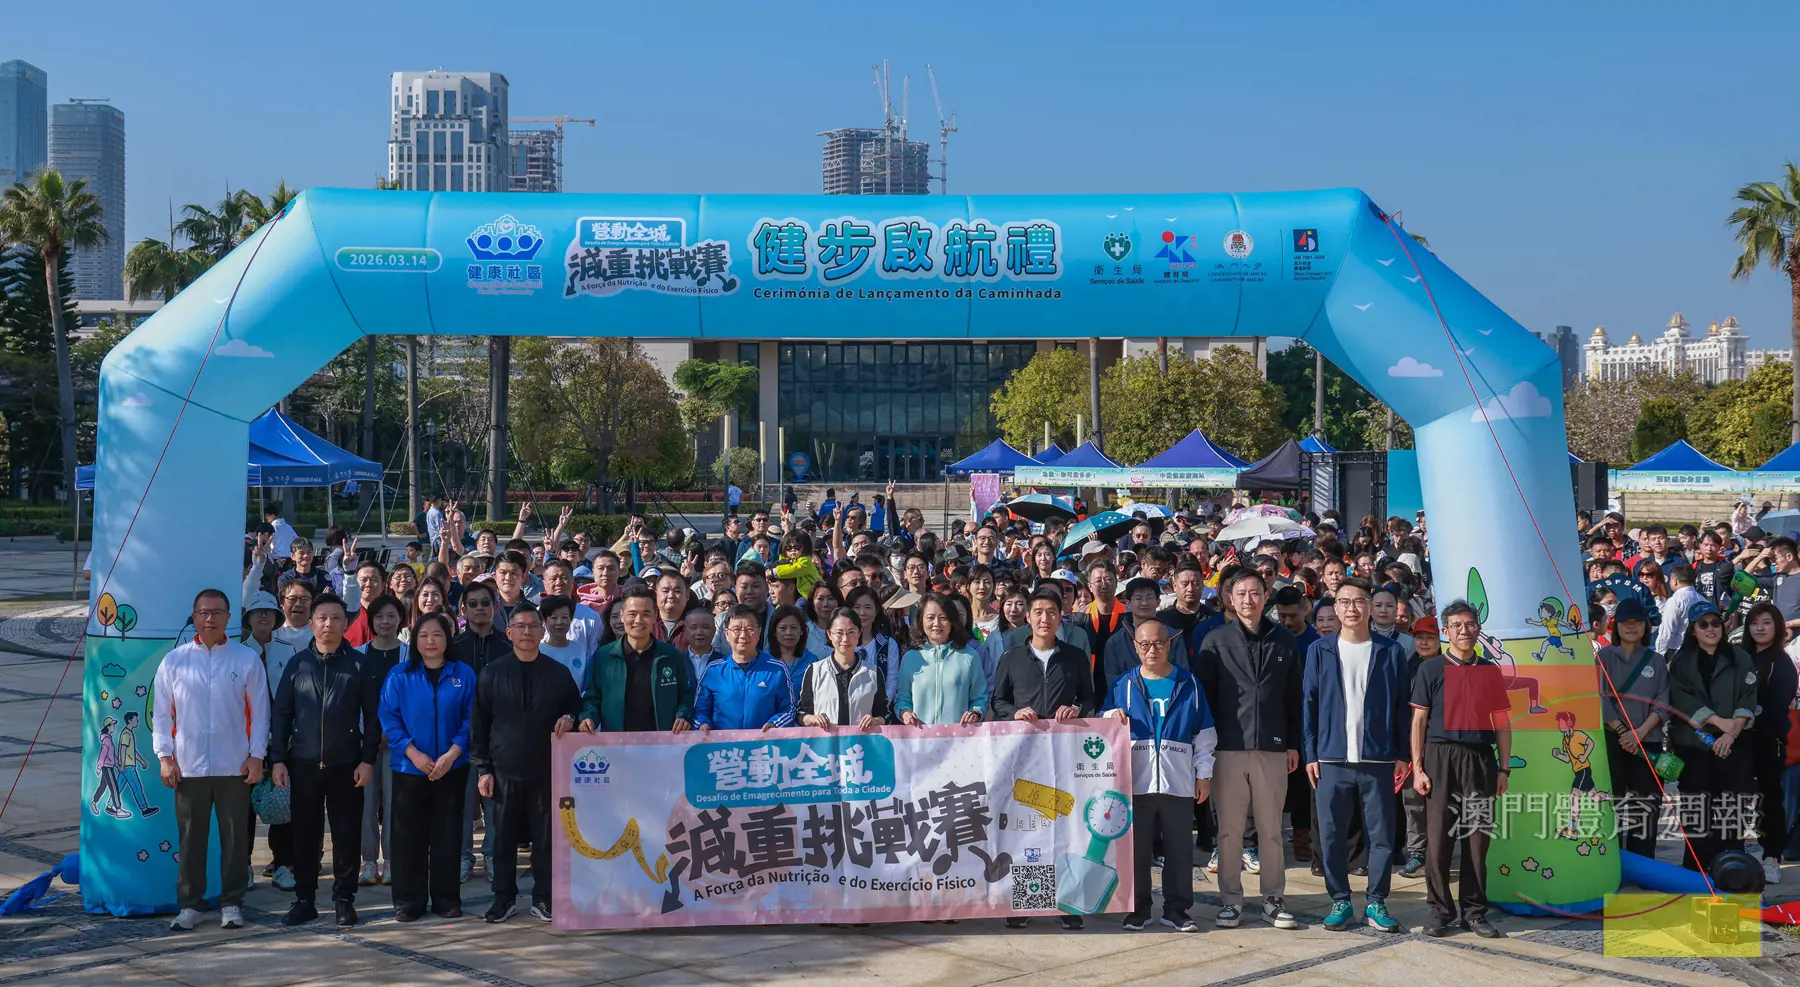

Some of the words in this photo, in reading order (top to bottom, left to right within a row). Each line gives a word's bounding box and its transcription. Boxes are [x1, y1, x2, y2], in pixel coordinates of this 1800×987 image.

[592, 222, 671, 242] 營動全城
[753, 220, 1058, 280] 健步啟航禮
[350, 254, 427, 266] 2026.03.14
[568, 243, 728, 282] 減重挑戰賽
[467, 264, 542, 280] 健康社區
[1094, 264, 1142, 276] 衛生局
[587, 282, 605, 290] Força
[617, 280, 647, 288] Nutrição
[667, 285, 697, 293] Exercício
[698, 286, 719, 294] Físico
[754, 286, 830, 299] Cerimónia
[836, 288, 853, 299] de
[859, 288, 950, 301] Lançamento
[955, 288, 972, 299] da
[978, 287, 1061, 299] Caminhada
[707, 743, 872, 790] 營動全城
[1076, 761, 1115, 771] 衛生局
[696, 792, 728, 802] Desafio
[730, 792, 741, 801] de
[743, 788, 811, 801] Emagrecimento
[812, 787, 831, 798] para
[833, 786, 853, 795] Toda
[861, 785, 891, 794] Cidade
[665, 781, 993, 880] 減重挑戰賽
[694, 889, 704, 901] A
[705, 880, 744, 897] Força
[747, 874, 765, 887] da
[768, 869, 830, 886] Nutrição
[838, 875, 847, 885] e
[849, 875, 867, 889] do
[870, 877, 933, 892] Exercício
[937, 875, 976, 891] Físico
